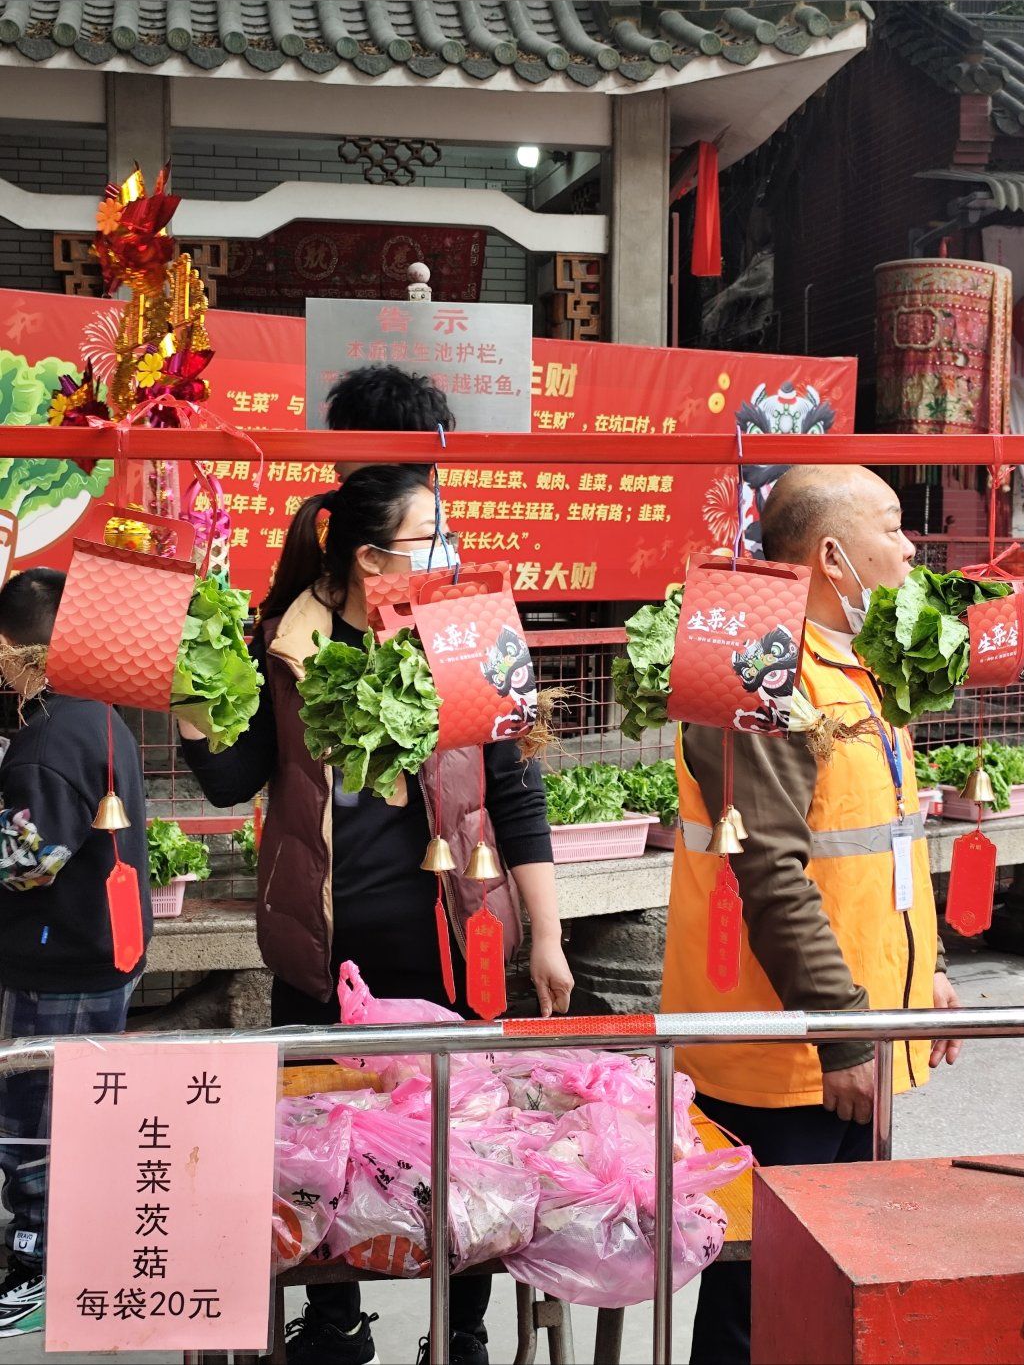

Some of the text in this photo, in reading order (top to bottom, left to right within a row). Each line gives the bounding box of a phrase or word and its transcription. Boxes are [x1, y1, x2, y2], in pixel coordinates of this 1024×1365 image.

[377, 306, 469, 334] 告示
[93, 1072, 221, 1105] 开光
[132, 1116, 171, 1279] 生菜茨菇
[76, 1288, 222, 1320] 每袋20元
